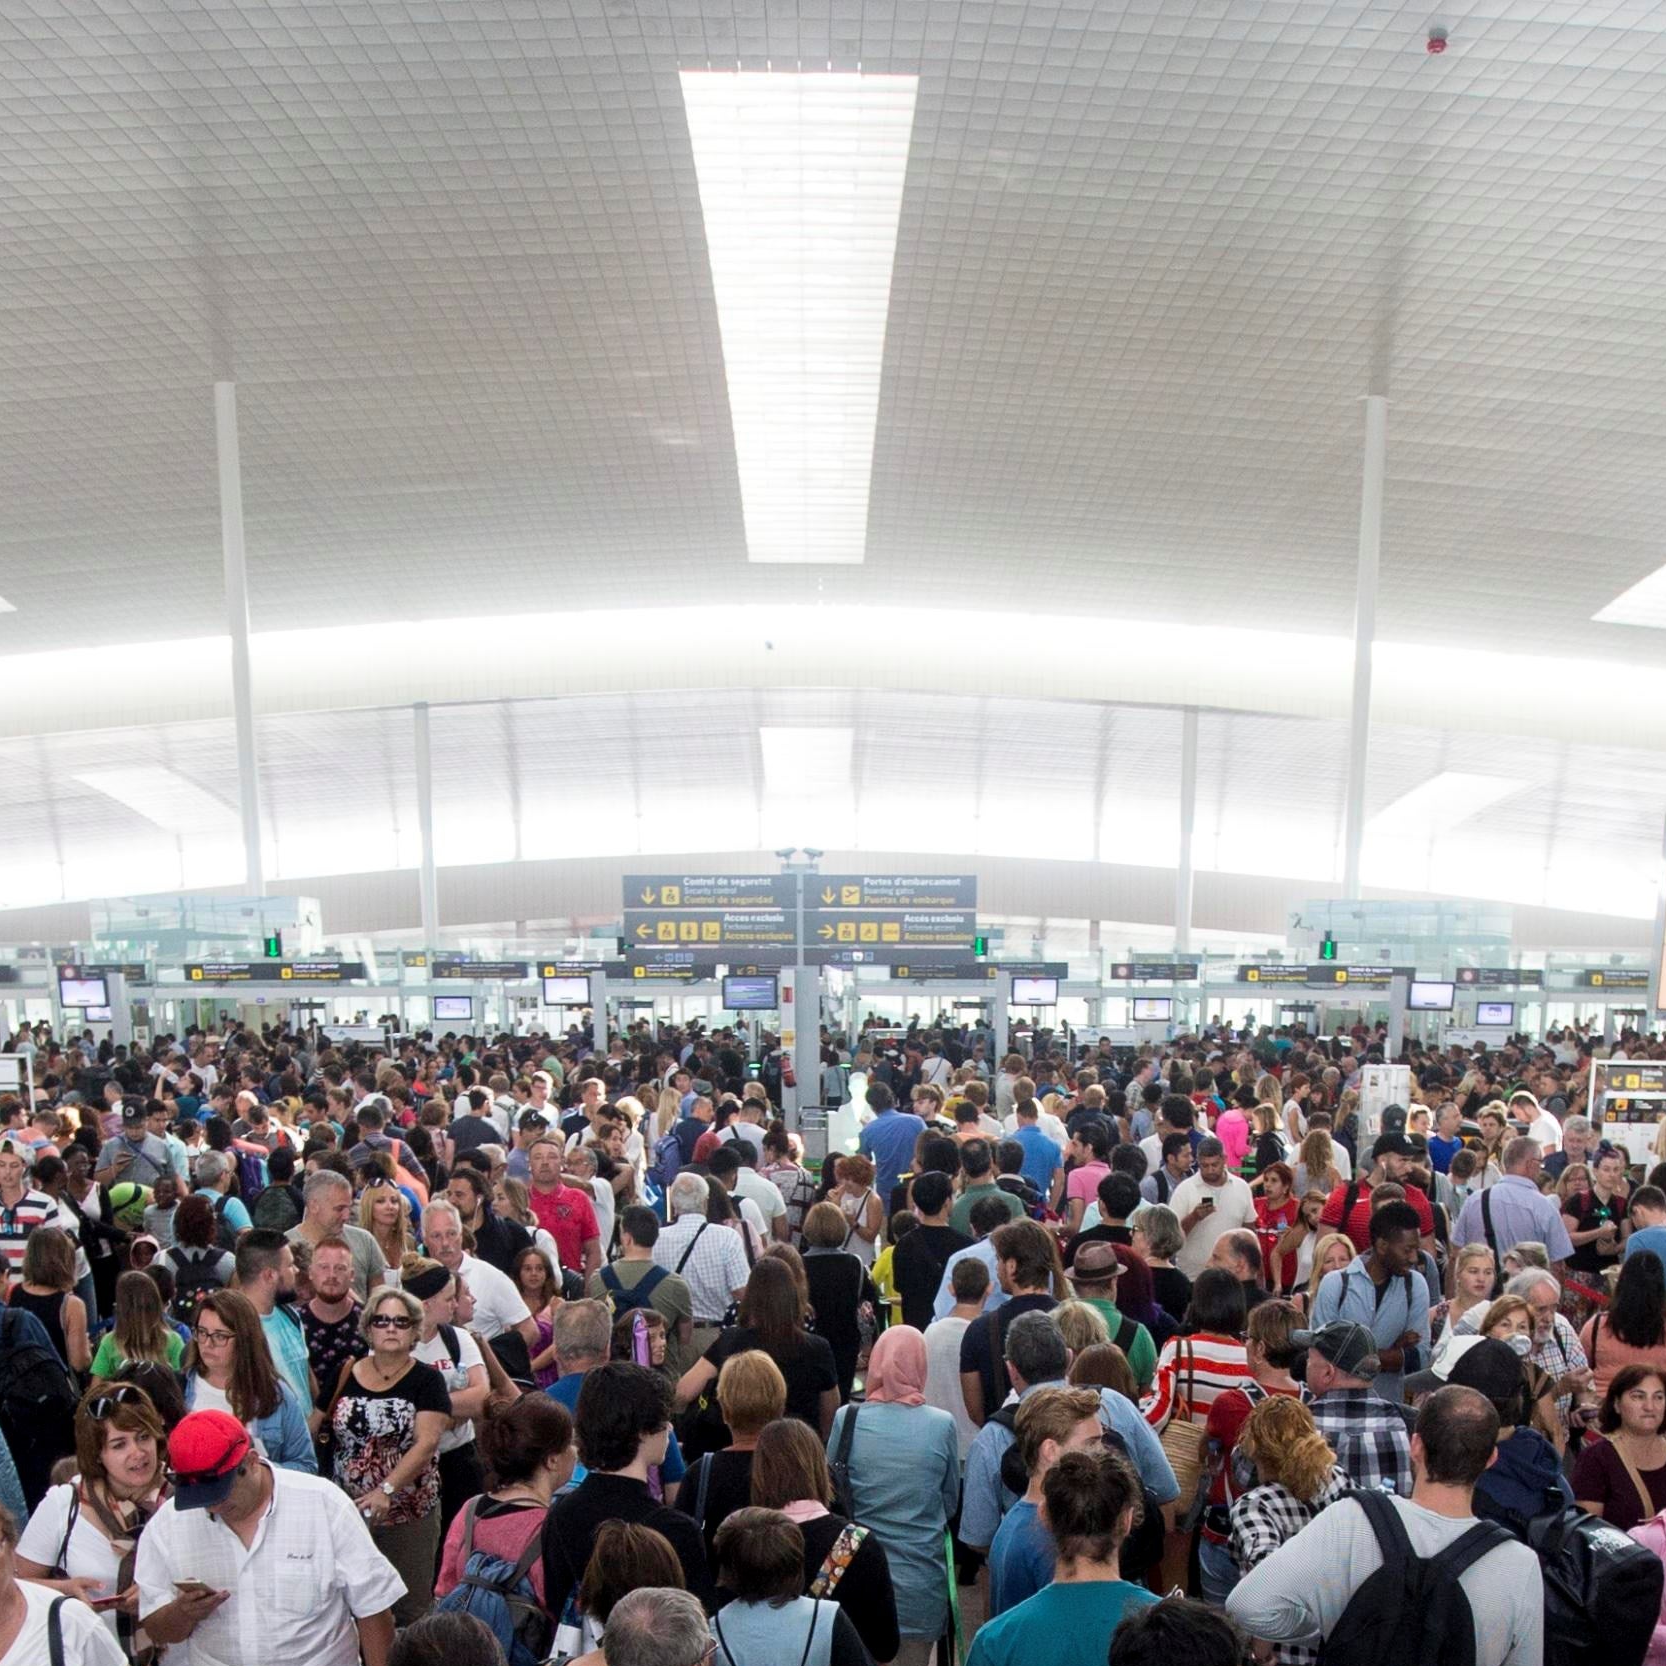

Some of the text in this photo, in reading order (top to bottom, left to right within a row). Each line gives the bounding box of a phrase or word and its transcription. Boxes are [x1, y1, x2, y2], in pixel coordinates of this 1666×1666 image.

[683, 877, 772, 887] Control de seguretat
[864, 877, 960, 886] Portes d'embarcament
[684, 896, 774, 905] Control de seguridad
